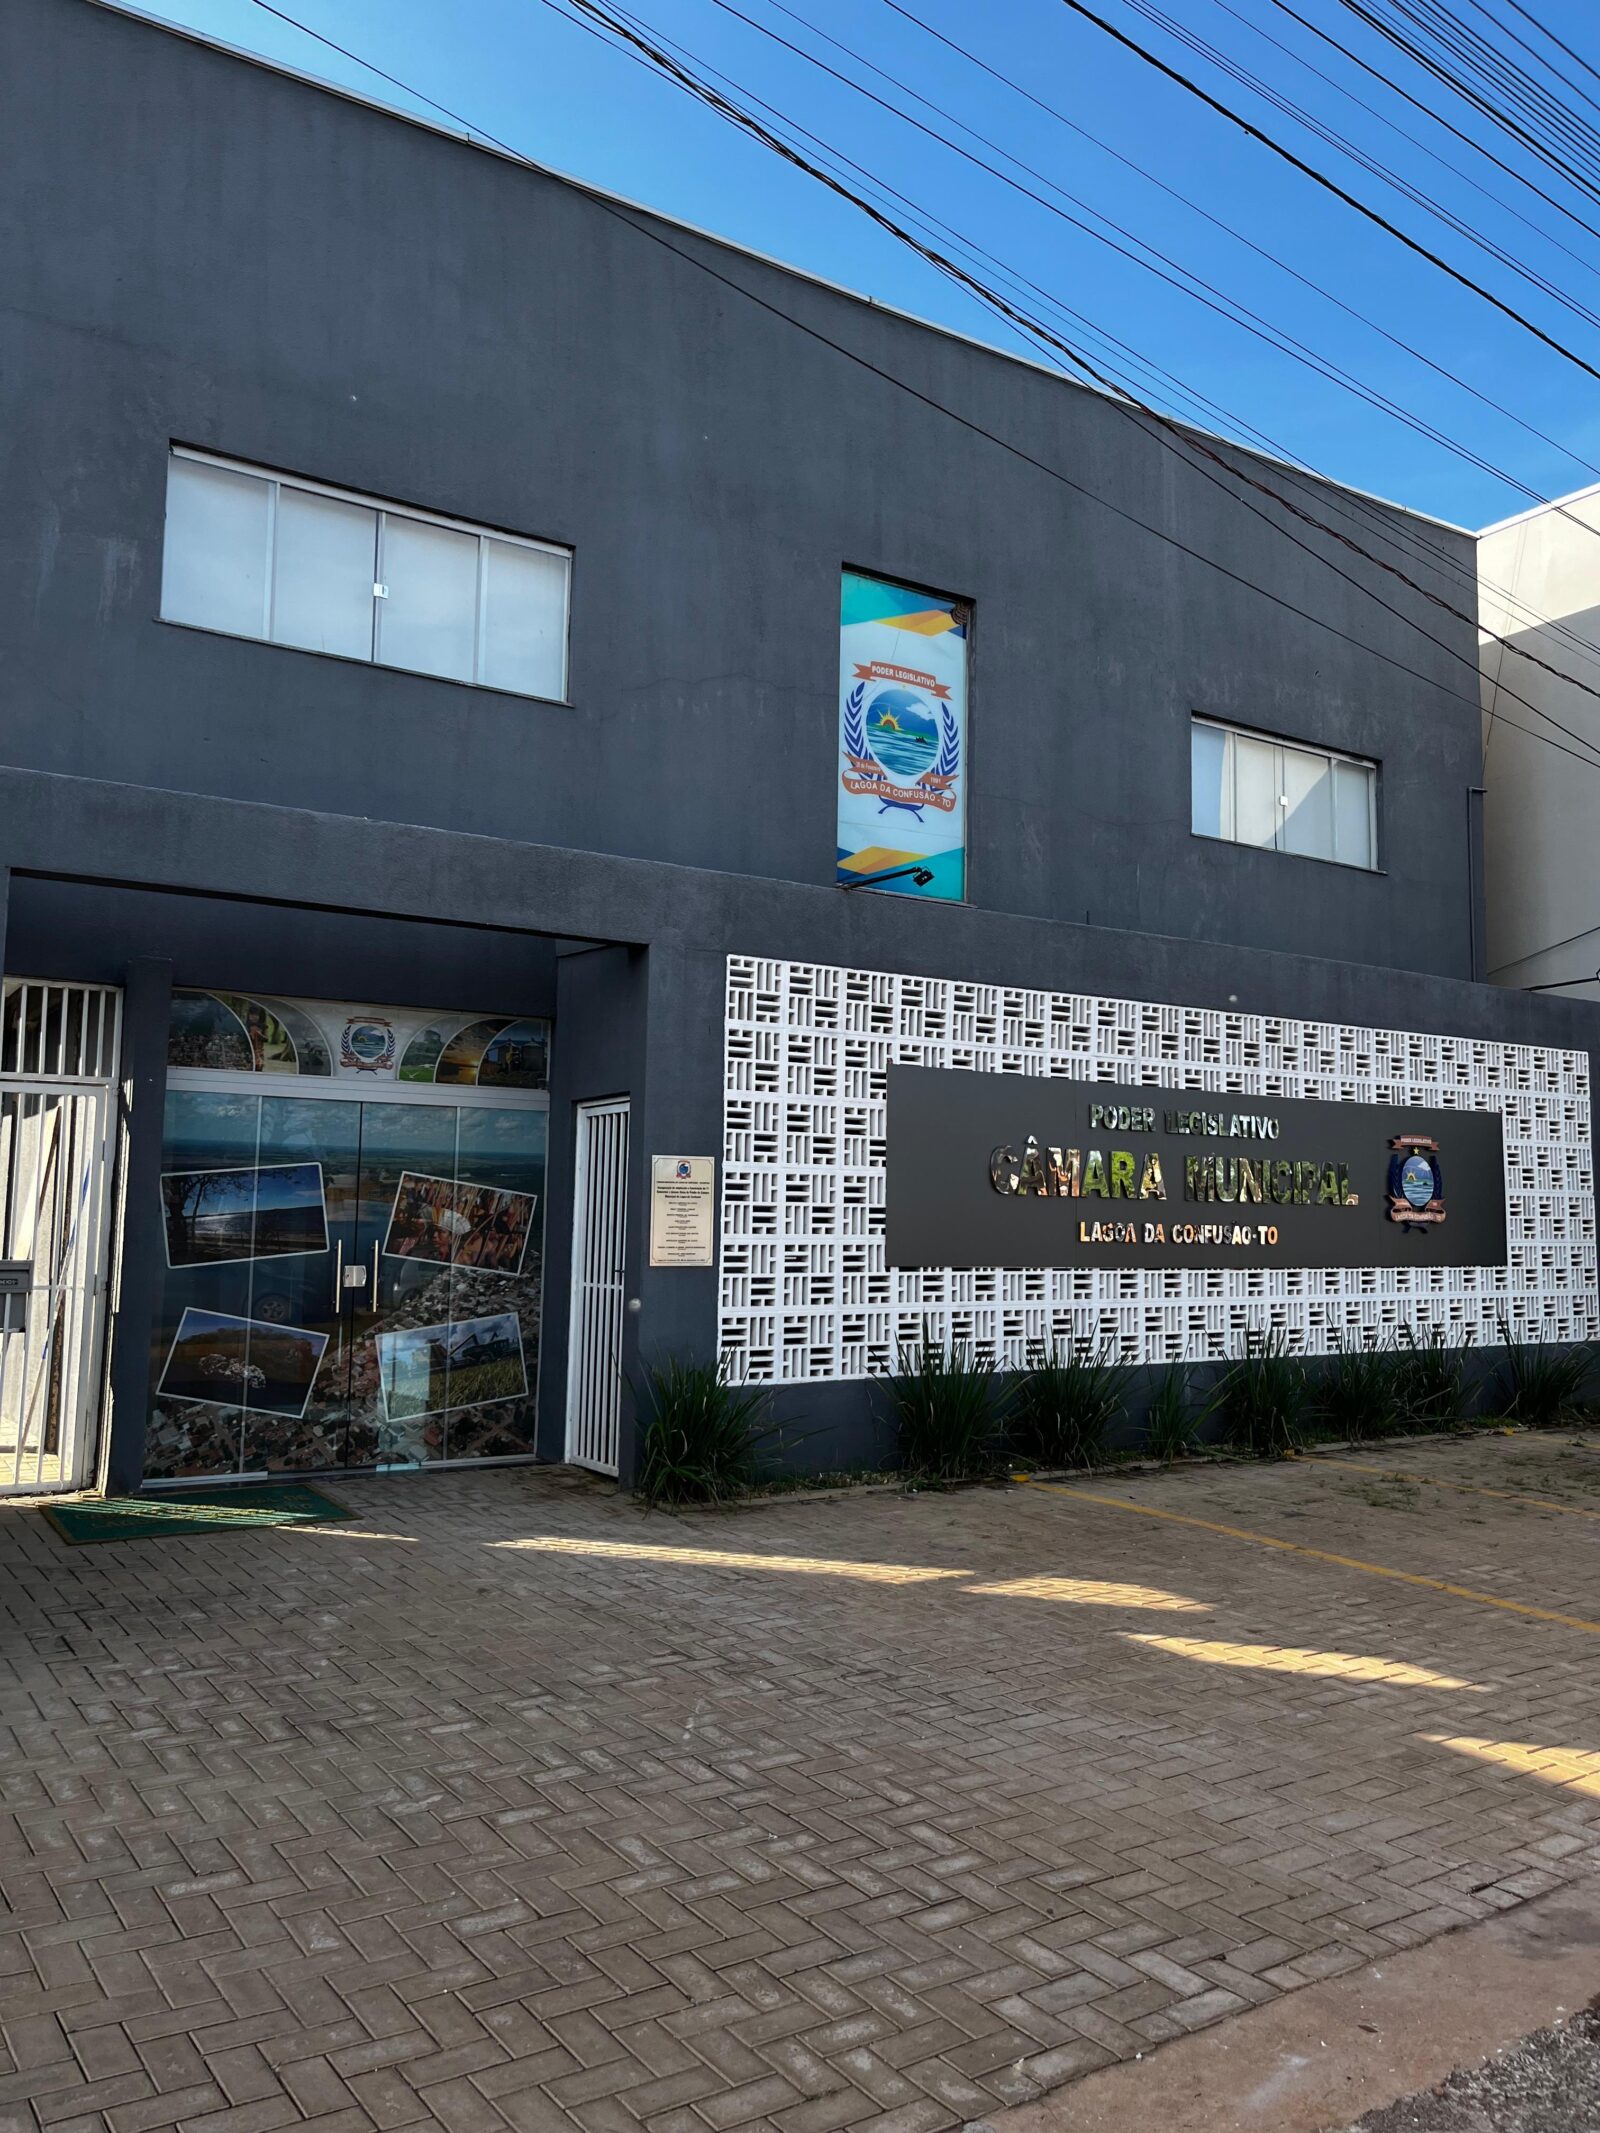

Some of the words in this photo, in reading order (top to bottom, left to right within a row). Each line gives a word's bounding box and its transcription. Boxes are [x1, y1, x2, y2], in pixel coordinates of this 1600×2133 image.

[871, 665, 894, 676] PODER
[895, 670, 936, 687] LEGISLATIVO
[850, 781, 878, 790] LAGOA
[880, 784, 891, 793] DA
[942, 798, 951, 808] TO
[1089, 1104, 1156, 1131] PODER
[1165, 1109, 1279, 1140] LEGISLATIVO
[990, 1135, 1167, 1201] CÂMARA
[1184, 1154, 1359, 1206] MUNICIPAL
[1079, 1221, 1137, 1243] LAGOA
[1144, 1223, 1166, 1243] DA
